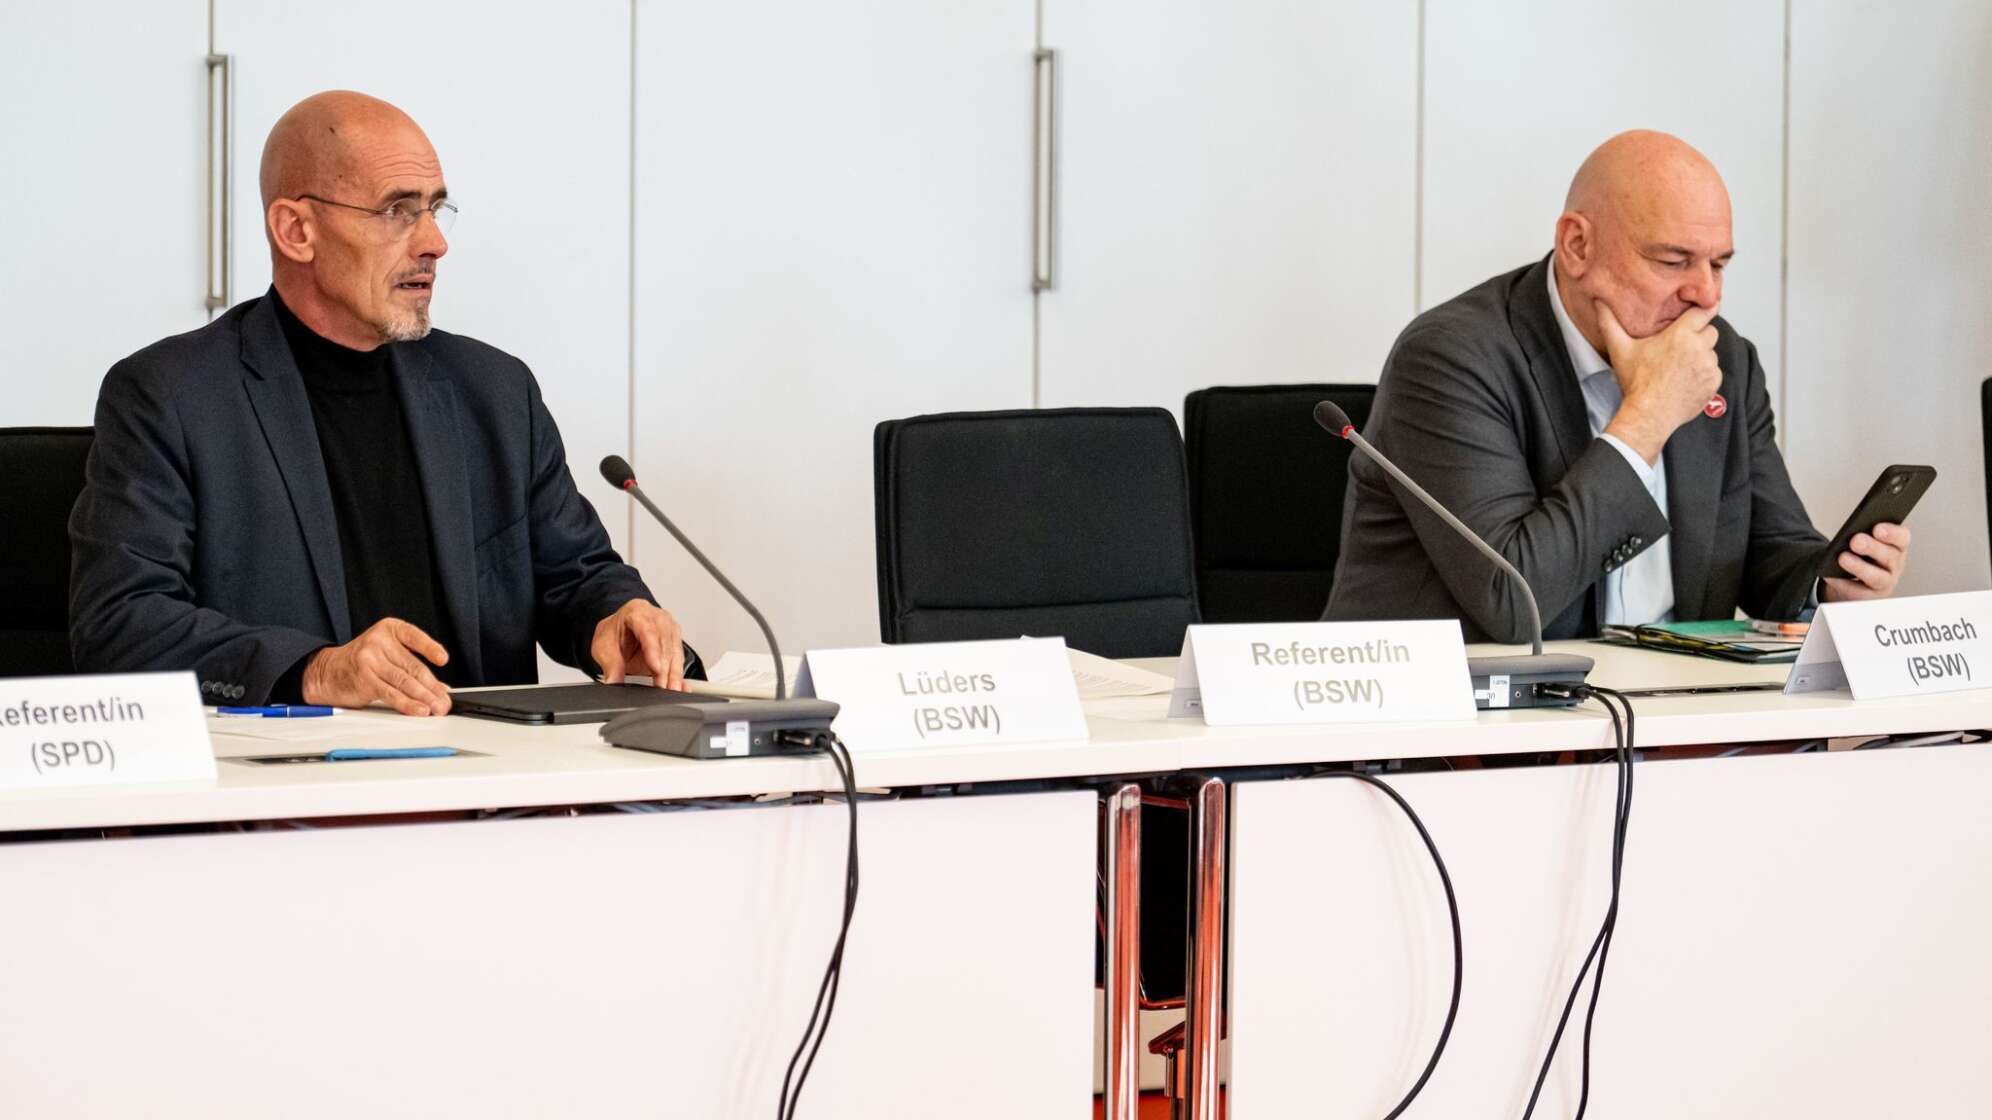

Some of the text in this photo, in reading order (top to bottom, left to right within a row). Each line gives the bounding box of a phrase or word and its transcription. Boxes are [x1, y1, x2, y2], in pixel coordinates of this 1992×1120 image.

[1874, 617, 1978, 647] Crumbach
[1251, 638, 1411, 667] Referent/in
[898, 669, 996, 696] Lüders
[1907, 652, 1971, 686] (BSW)
[1294, 678, 1383, 711] (BSW)
[0, 697, 144, 726] eferent/in
[914, 704, 1000, 739] (BSW)
[31, 740, 115, 774] (SPD)
